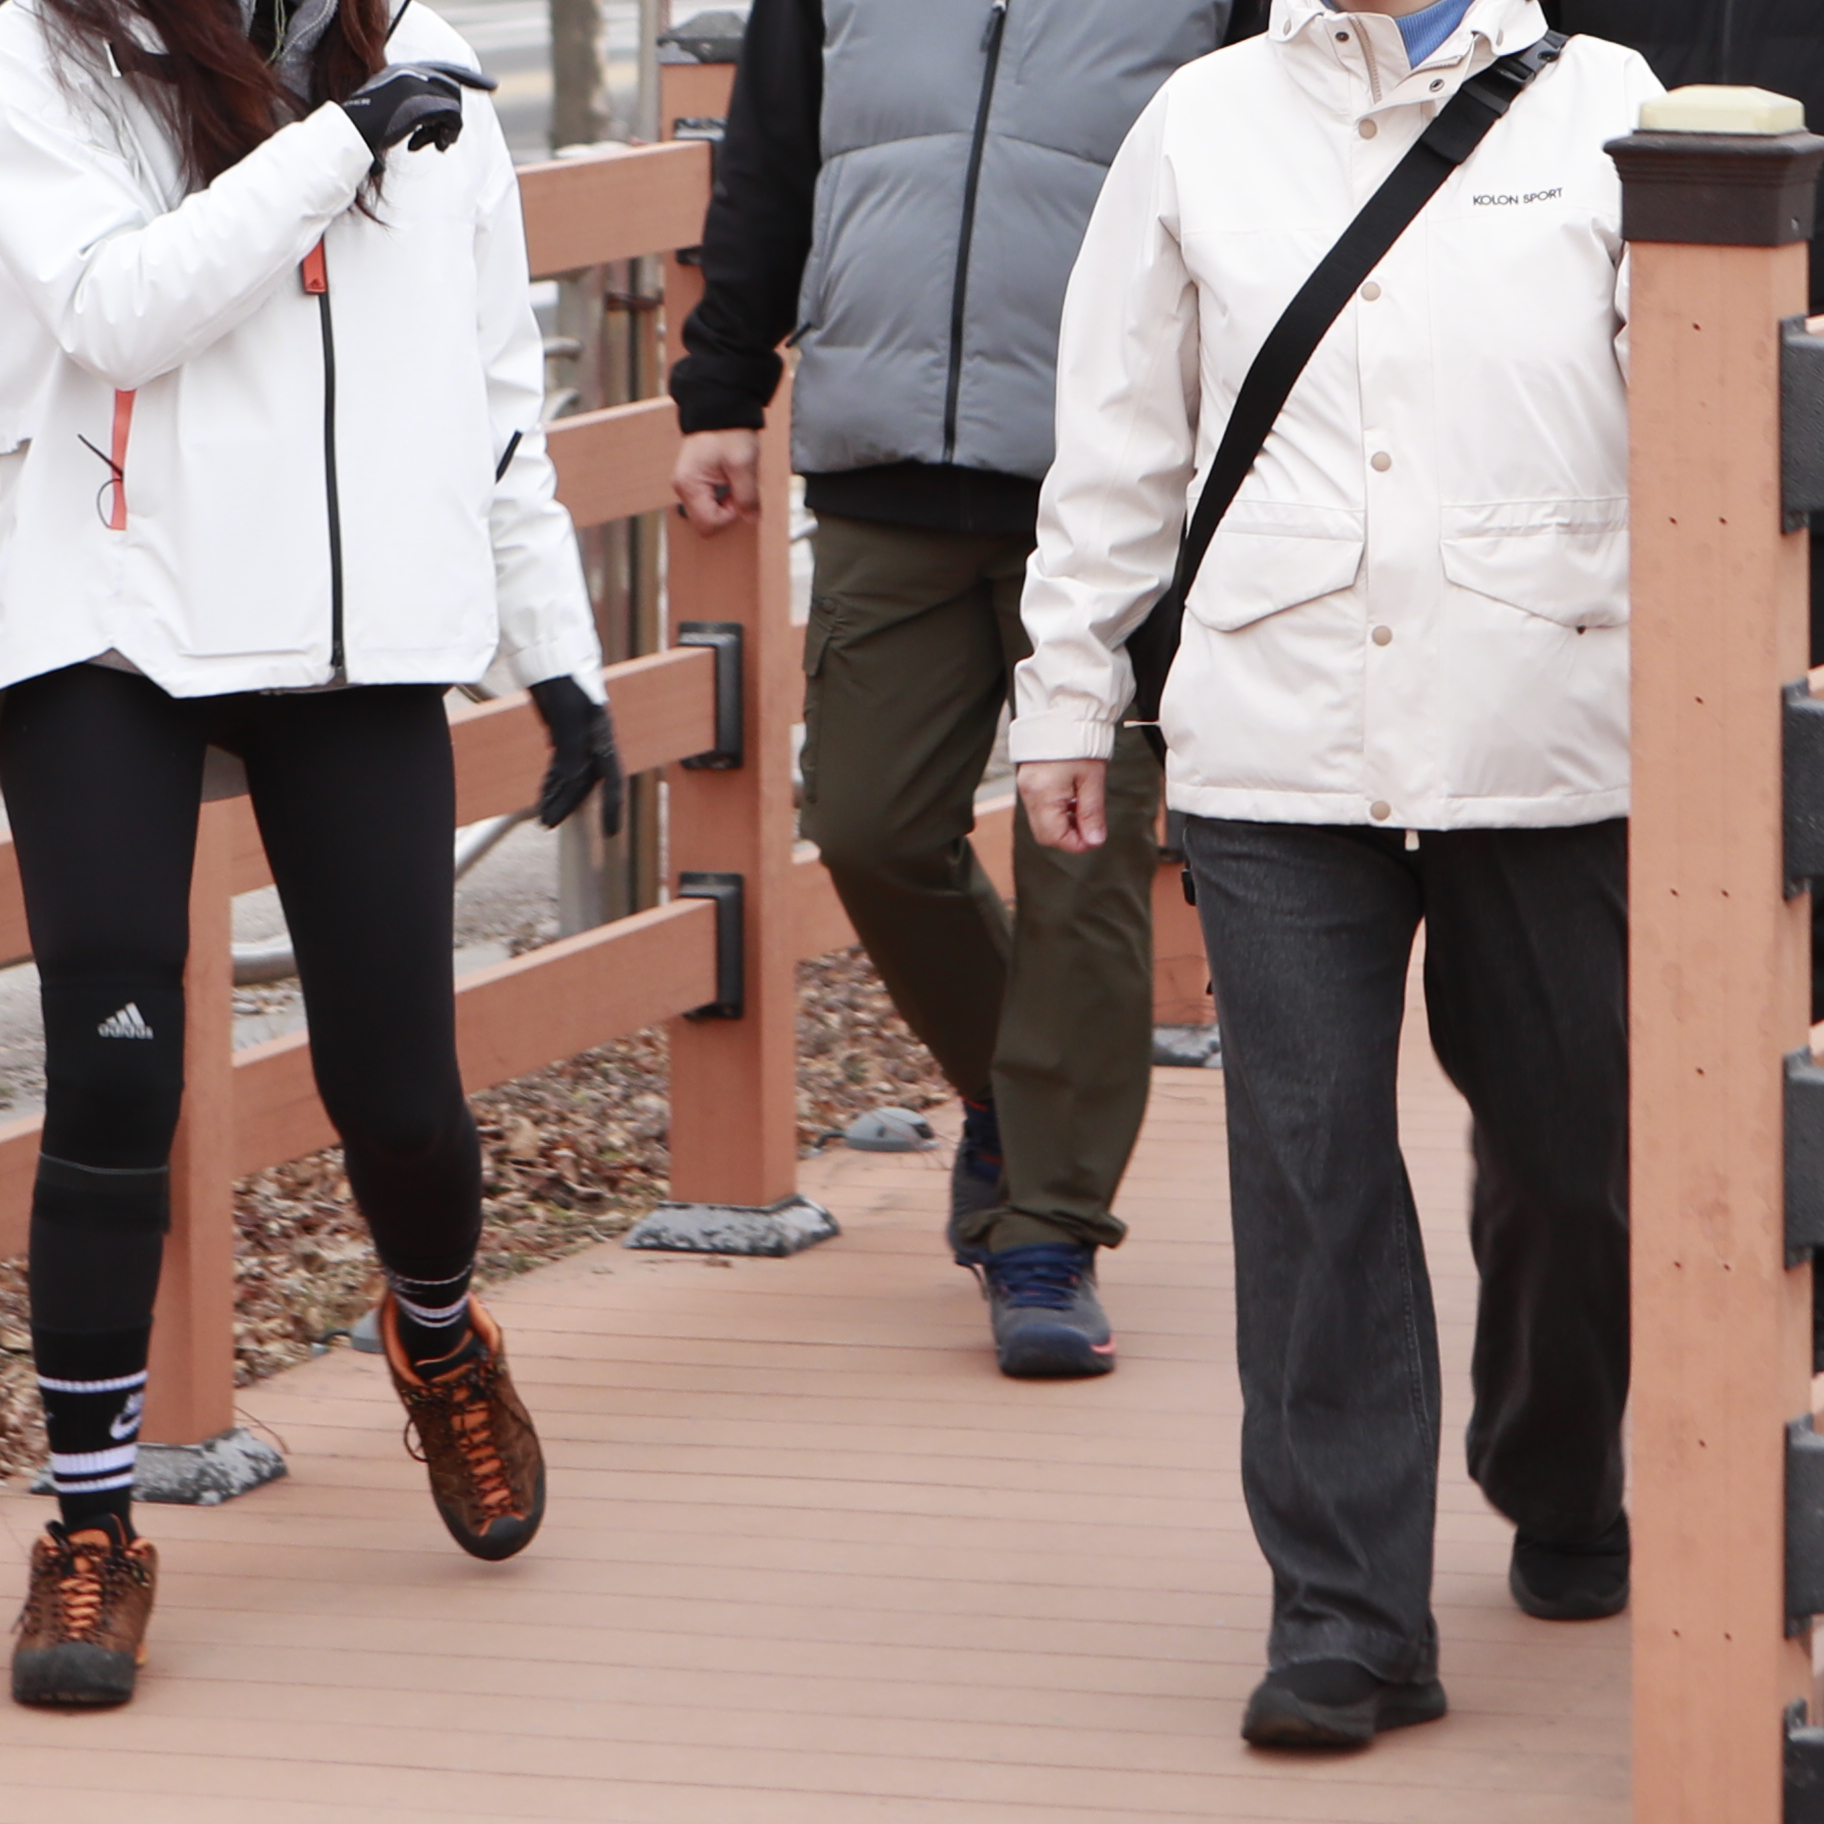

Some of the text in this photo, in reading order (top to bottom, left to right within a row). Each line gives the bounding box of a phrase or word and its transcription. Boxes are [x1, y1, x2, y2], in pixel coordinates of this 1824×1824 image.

[1472, 186, 1564, 206] KOLON SPORT
[97, 1020, 155, 1041] adidas
